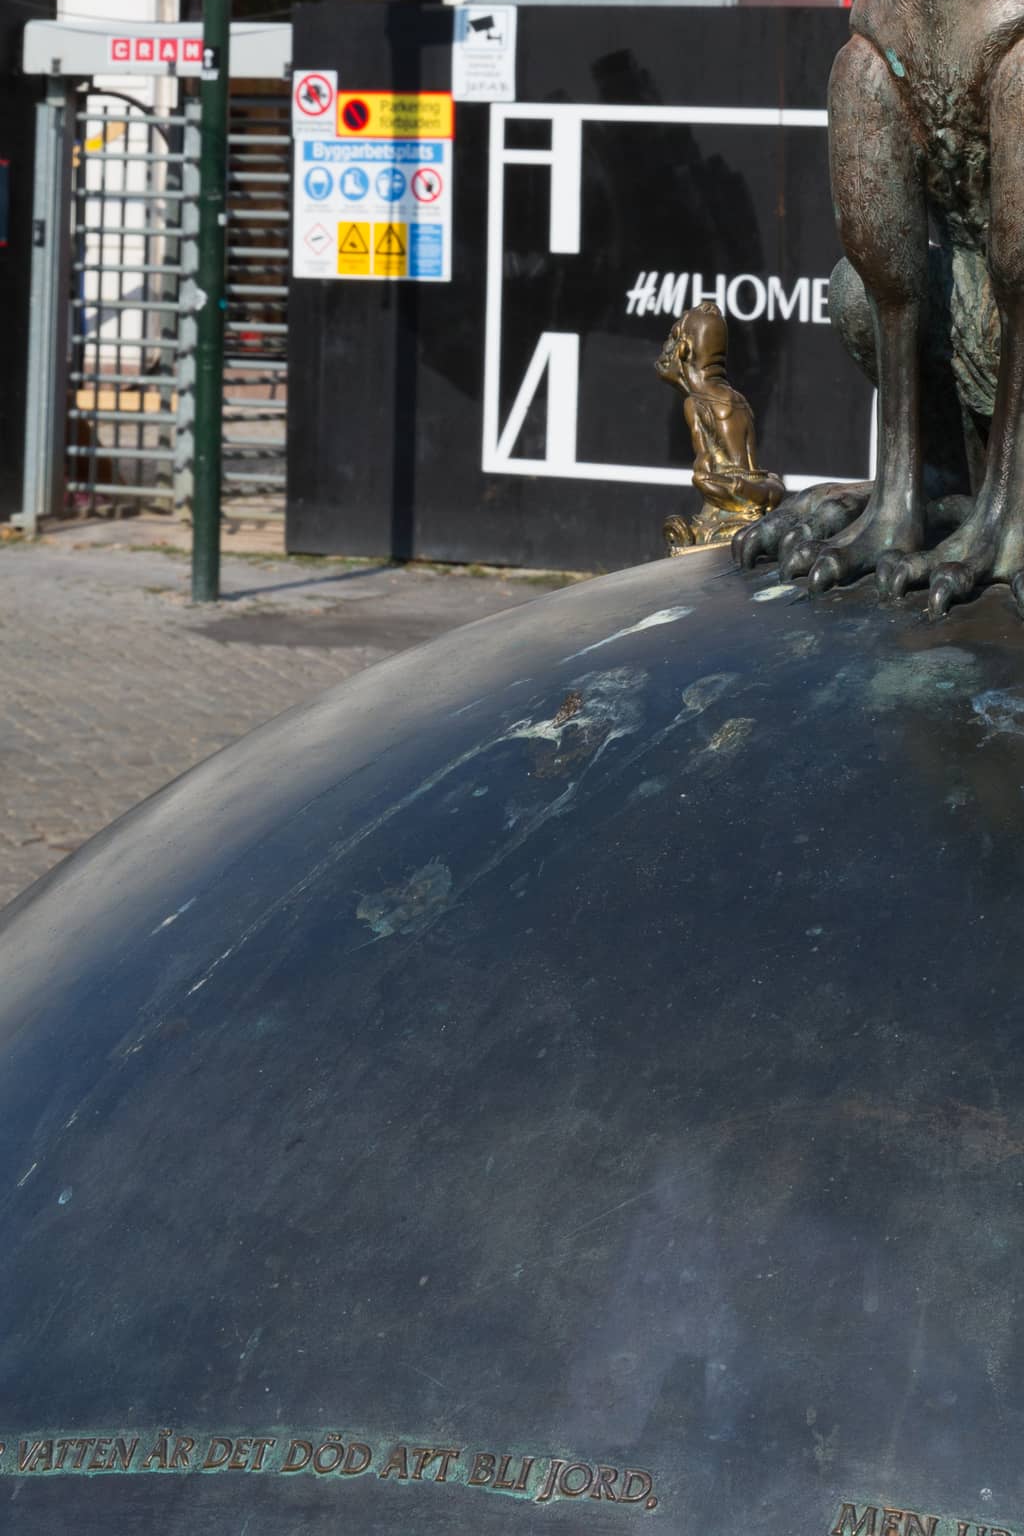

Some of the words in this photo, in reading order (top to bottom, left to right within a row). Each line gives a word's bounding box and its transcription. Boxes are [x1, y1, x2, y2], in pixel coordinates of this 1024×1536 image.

[112, 39, 204, 61] CRAM
[312, 143, 435, 163] Byggarbetsplats
[625, 271, 689, 319] H&M
[692, 272, 832, 324] HOME
[17, 1437, 140, 1472] VATTEN
[142, 1428, 195, 1469] ÄR
[202, 1437, 276, 1471] DET
[281, 1433, 373, 1475] DÖD
[379, 1446, 460, 1482] ATT
[467, 1451, 535, 1491] BLI
[535, 1458, 658, 1510] JORD,
[830, 1503, 940, 1536] MEN
